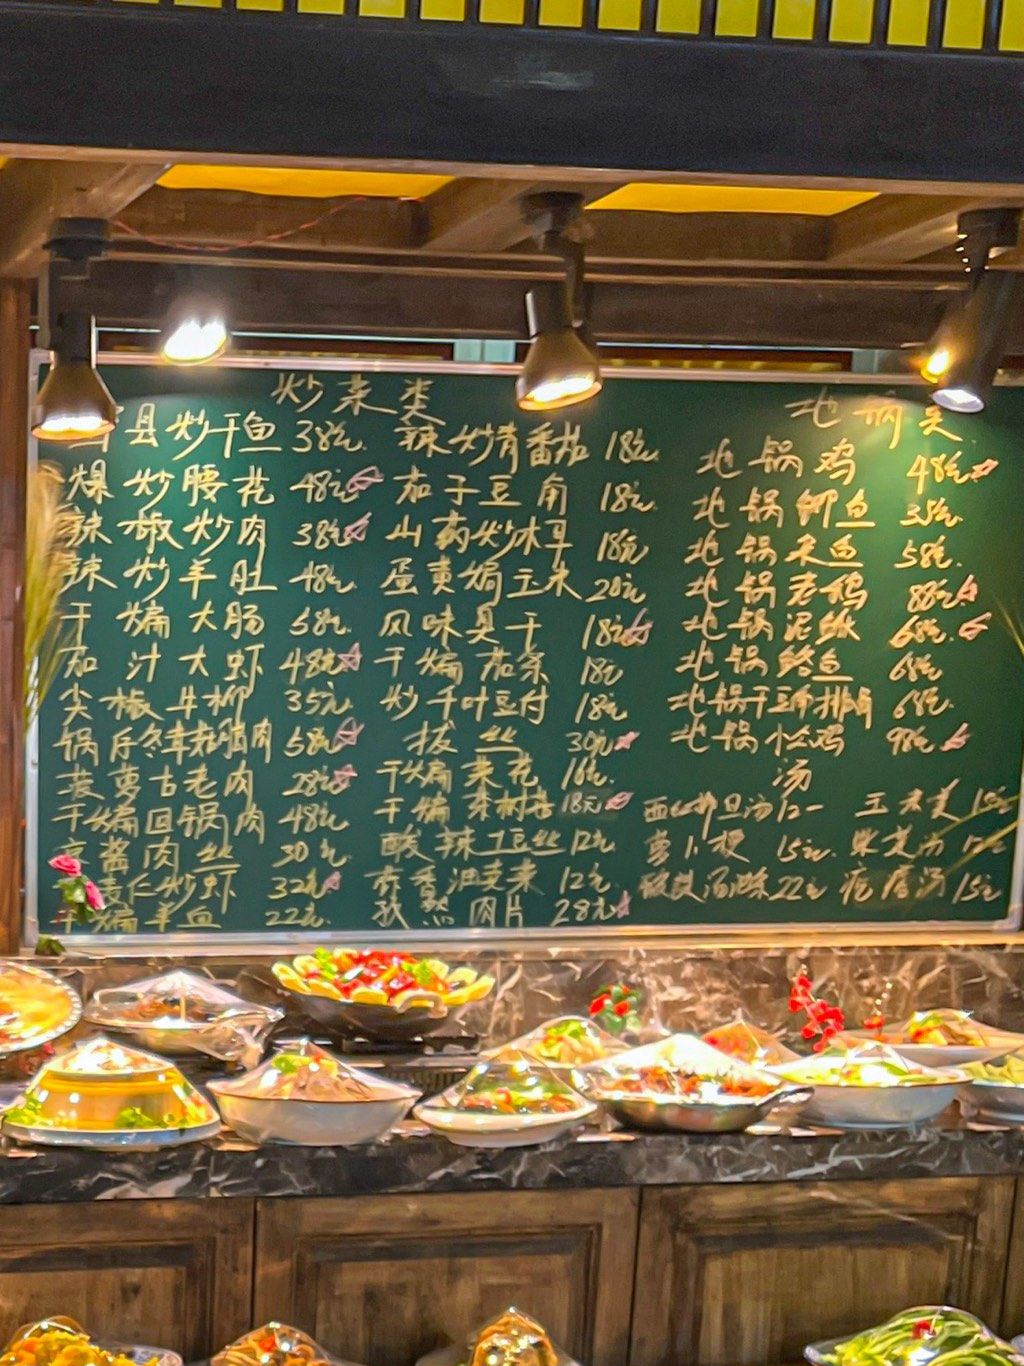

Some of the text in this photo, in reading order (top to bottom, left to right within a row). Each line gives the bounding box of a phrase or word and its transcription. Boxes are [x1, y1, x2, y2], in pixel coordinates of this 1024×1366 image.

[271, 373, 446, 426] 炒菜类
[66, 459, 276, 511] 爆炒腰花
[695, 436, 856, 486] 地锅鸡
[393, 464, 568, 516] 茄子豆角
